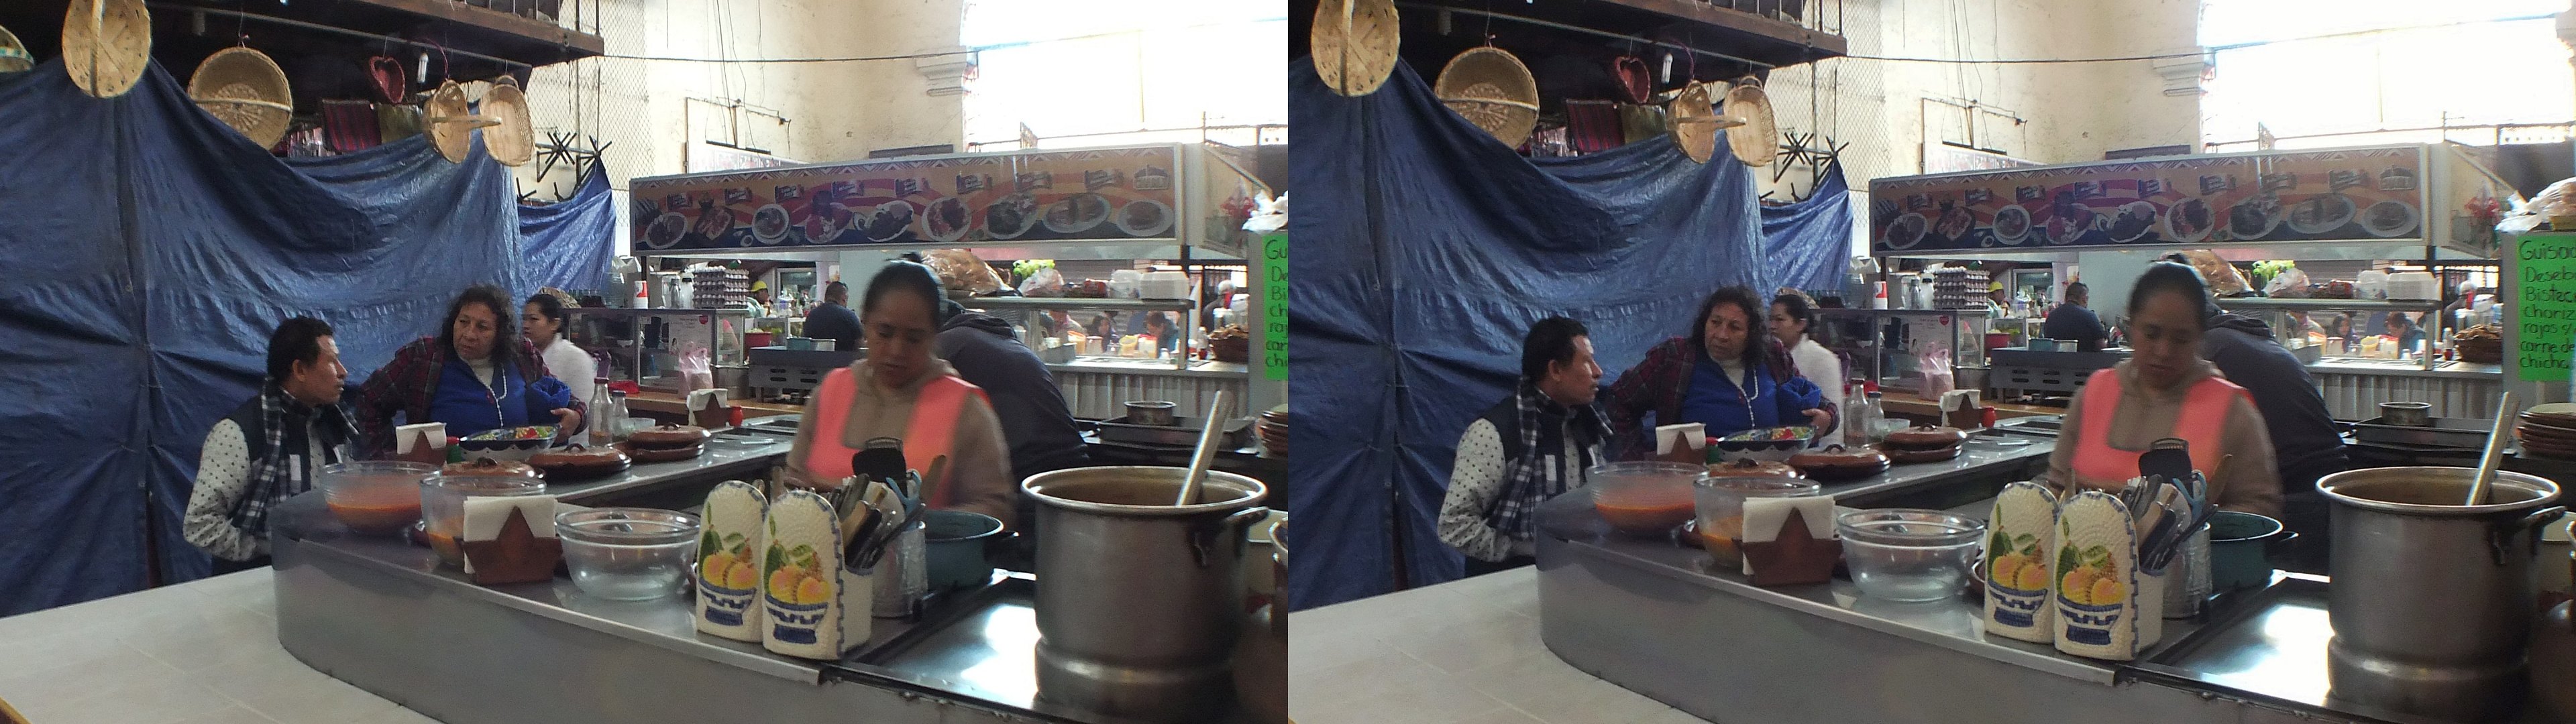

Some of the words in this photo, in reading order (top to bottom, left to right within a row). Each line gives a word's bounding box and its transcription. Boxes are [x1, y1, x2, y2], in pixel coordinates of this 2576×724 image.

[2525, 265, 2576, 282] Deseb
[2525, 284, 2576, 302] Bistec
[2520, 341, 2558, 353] carne
[2561, 337, 2575, 353] de
